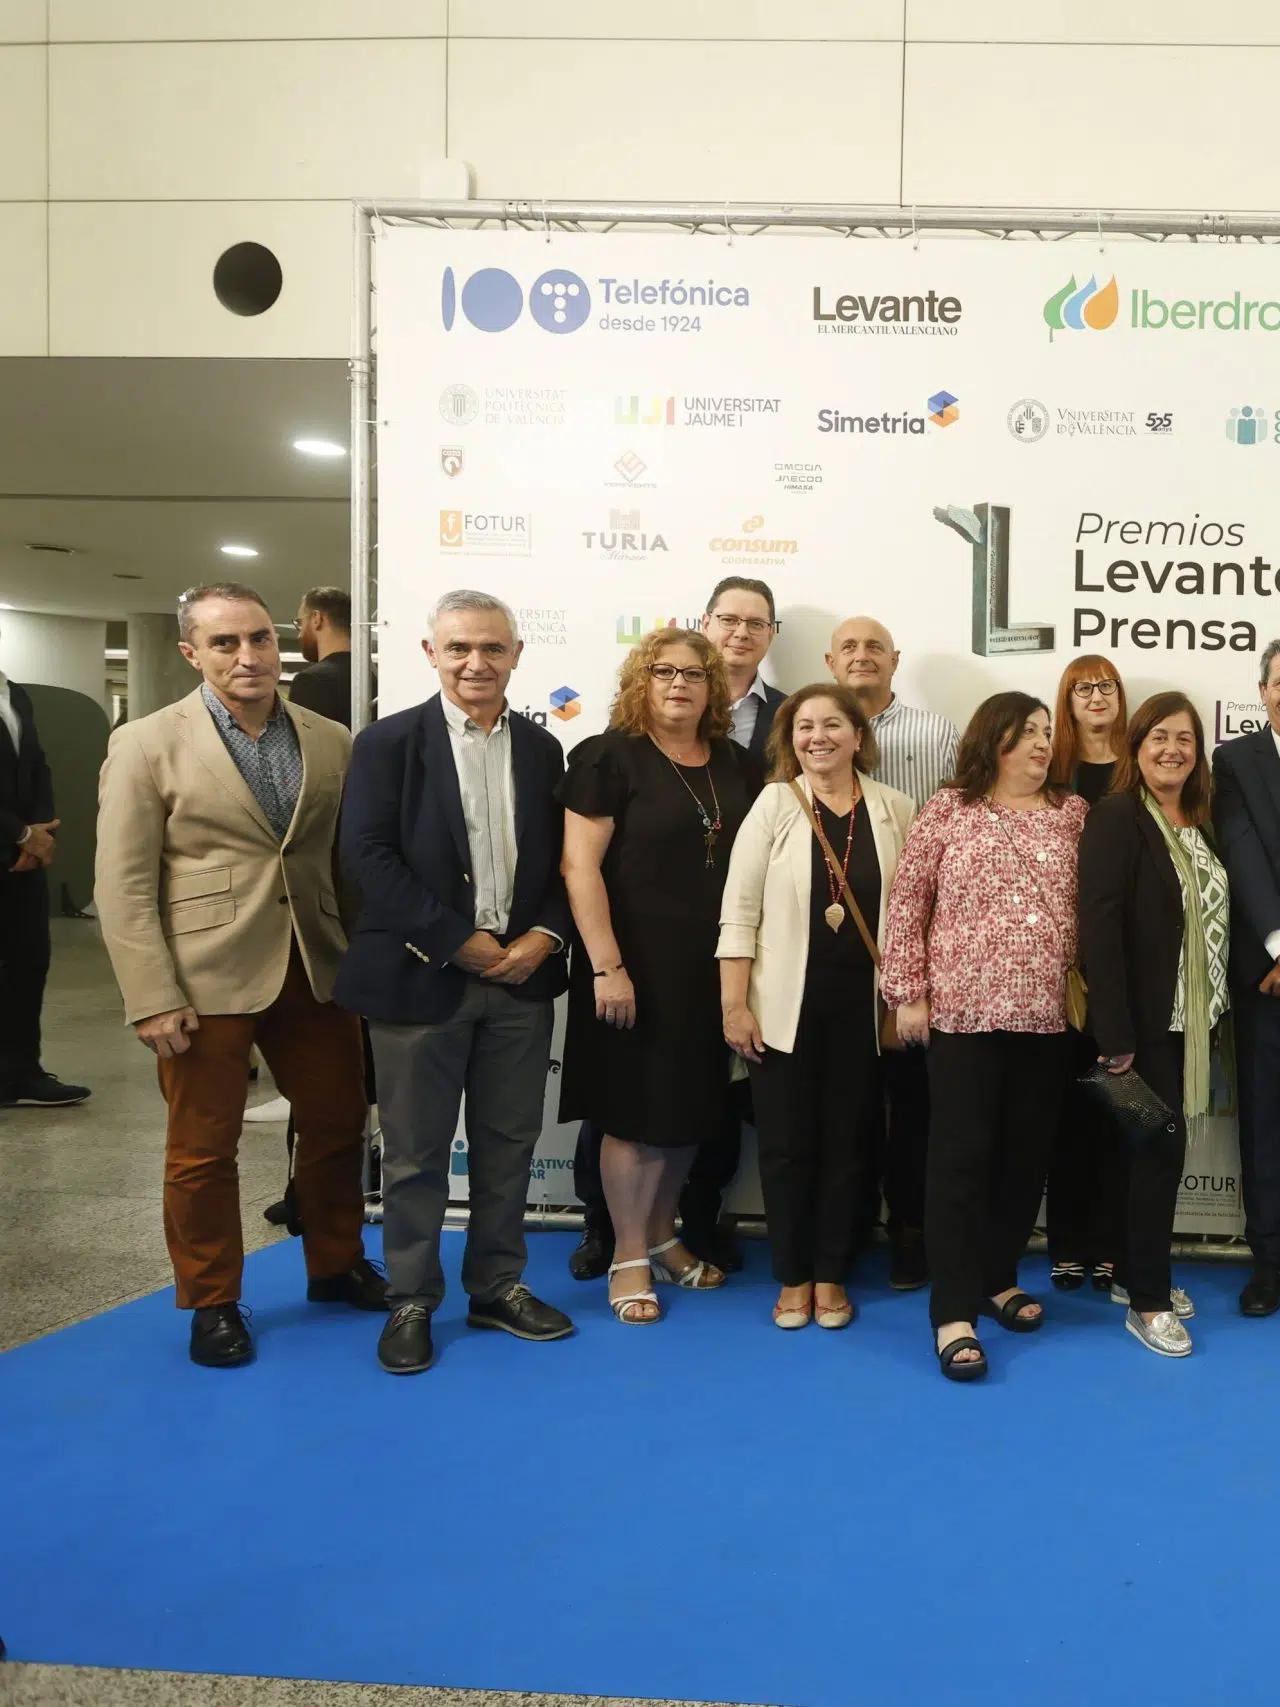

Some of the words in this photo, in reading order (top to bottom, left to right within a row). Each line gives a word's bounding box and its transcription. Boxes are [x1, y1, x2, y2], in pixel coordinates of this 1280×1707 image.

[599, 277, 750, 307] Telefónica
[813, 287, 962, 323] Levante
[599, 315, 656, 331] desde
[662, 316, 701, 332] 1924
[818, 325, 831, 334] EL
[832, 325, 891, 335] MERCANTIL
[892, 326, 958, 336] VALENCIANO
[684, 397, 781, 413] UNIVERSITAT
[684, 412, 734, 426] JAUME
[817, 408, 926, 435] Simetría
[1145, 412, 1173, 432] 525
[464, 514, 526, 532] FOTUR
[1075, 512, 1246, 549] Premios
[582, 532, 669, 551] TURIA
[708, 536, 799, 555] consum
[720, 556, 786, 566] COOPERATIVA
[519, 608, 568, 621] ERSITAT
[1072, 608, 1257, 652] Prensa
[1226, 701, 1267, 713] Premio
[530, 1158, 576, 1170] RATIVO
[1180, 1175, 1236, 1193] OTUR
